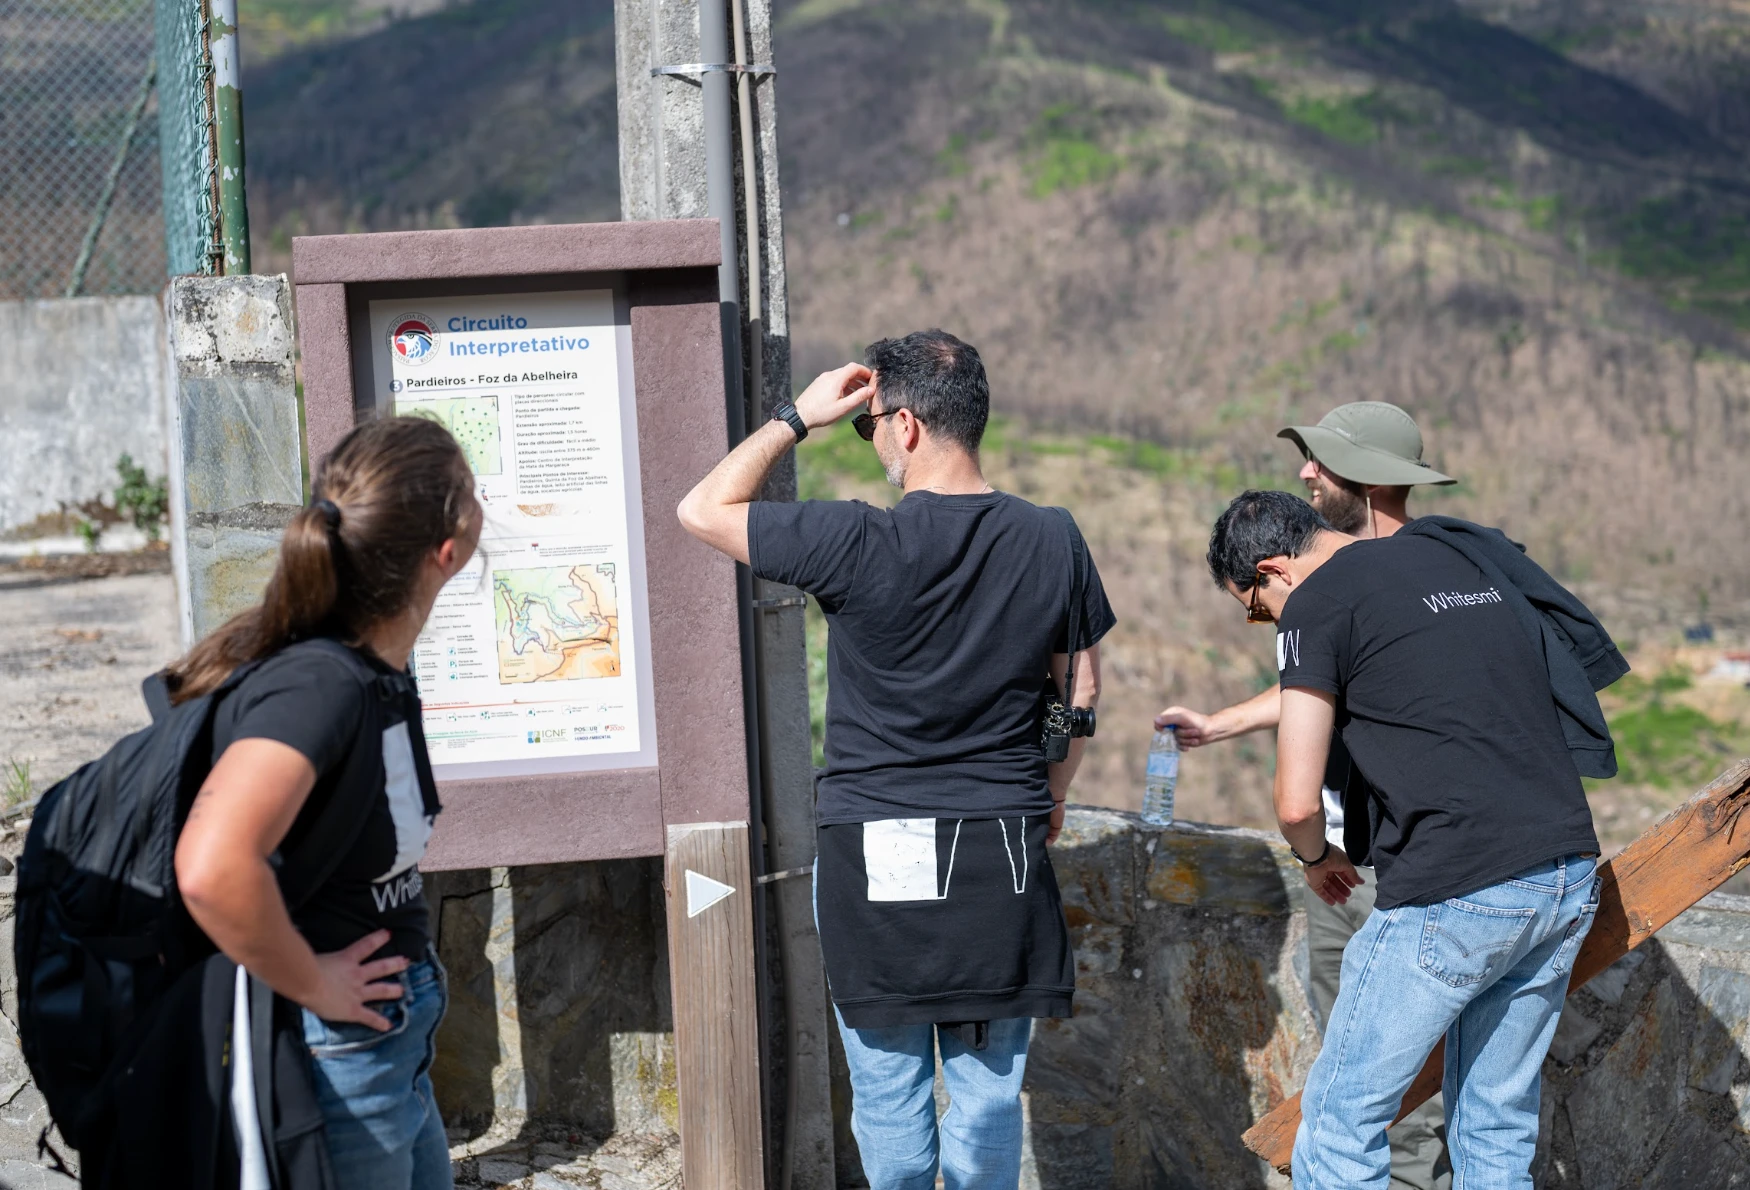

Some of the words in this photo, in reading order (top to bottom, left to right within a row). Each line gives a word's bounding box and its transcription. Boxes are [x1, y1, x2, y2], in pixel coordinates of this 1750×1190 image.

[448, 314, 527, 332] Circuito
[450, 336, 590, 357] Interpretativo
[406, 377, 466, 388] Pardieiros
[478, 374, 499, 384] Foz
[503, 373, 518, 382] da
[522, 370, 578, 382] Abelheira
[1422, 587, 1502, 614] Whitesmi
[542, 729, 566, 738] ICNF
